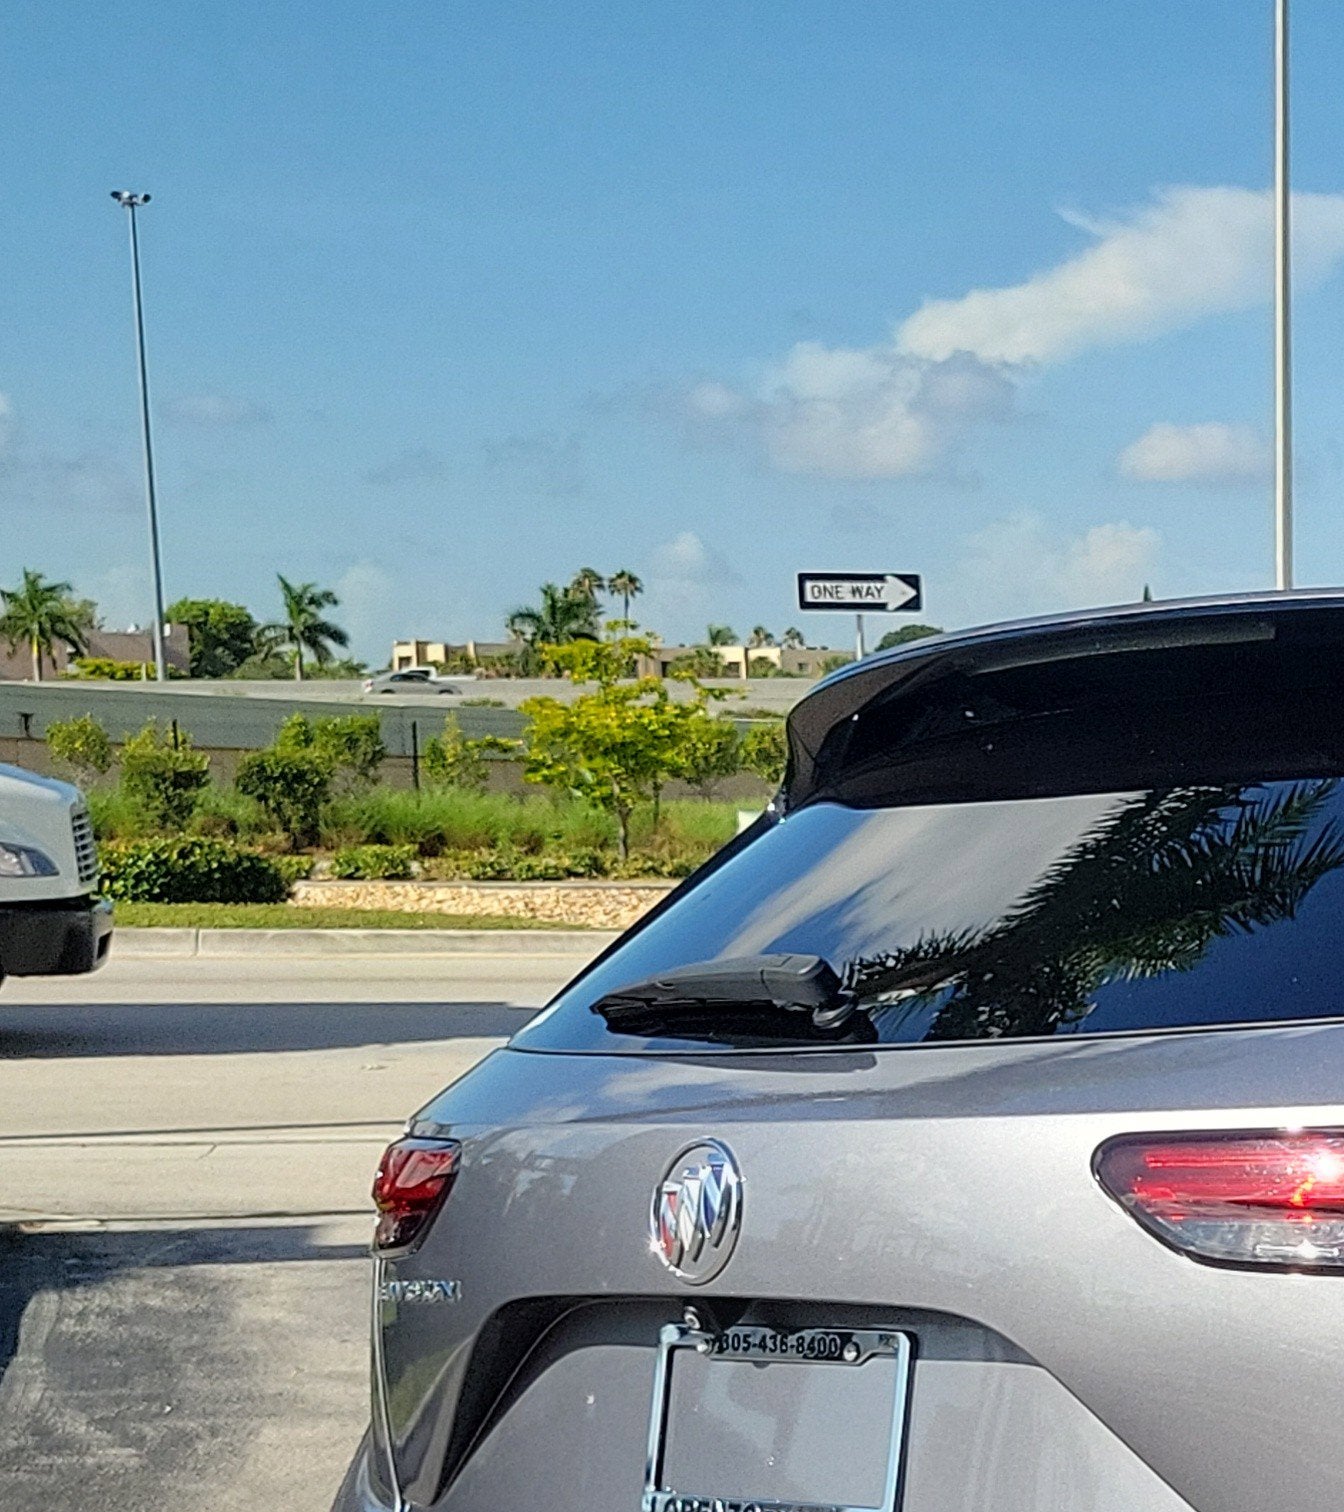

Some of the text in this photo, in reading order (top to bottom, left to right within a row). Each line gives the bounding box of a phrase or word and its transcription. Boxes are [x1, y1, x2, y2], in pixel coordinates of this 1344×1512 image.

[811, 584, 884, 600] ONE WAY
[721, 1332, 842, 1356] 305-436-8400
